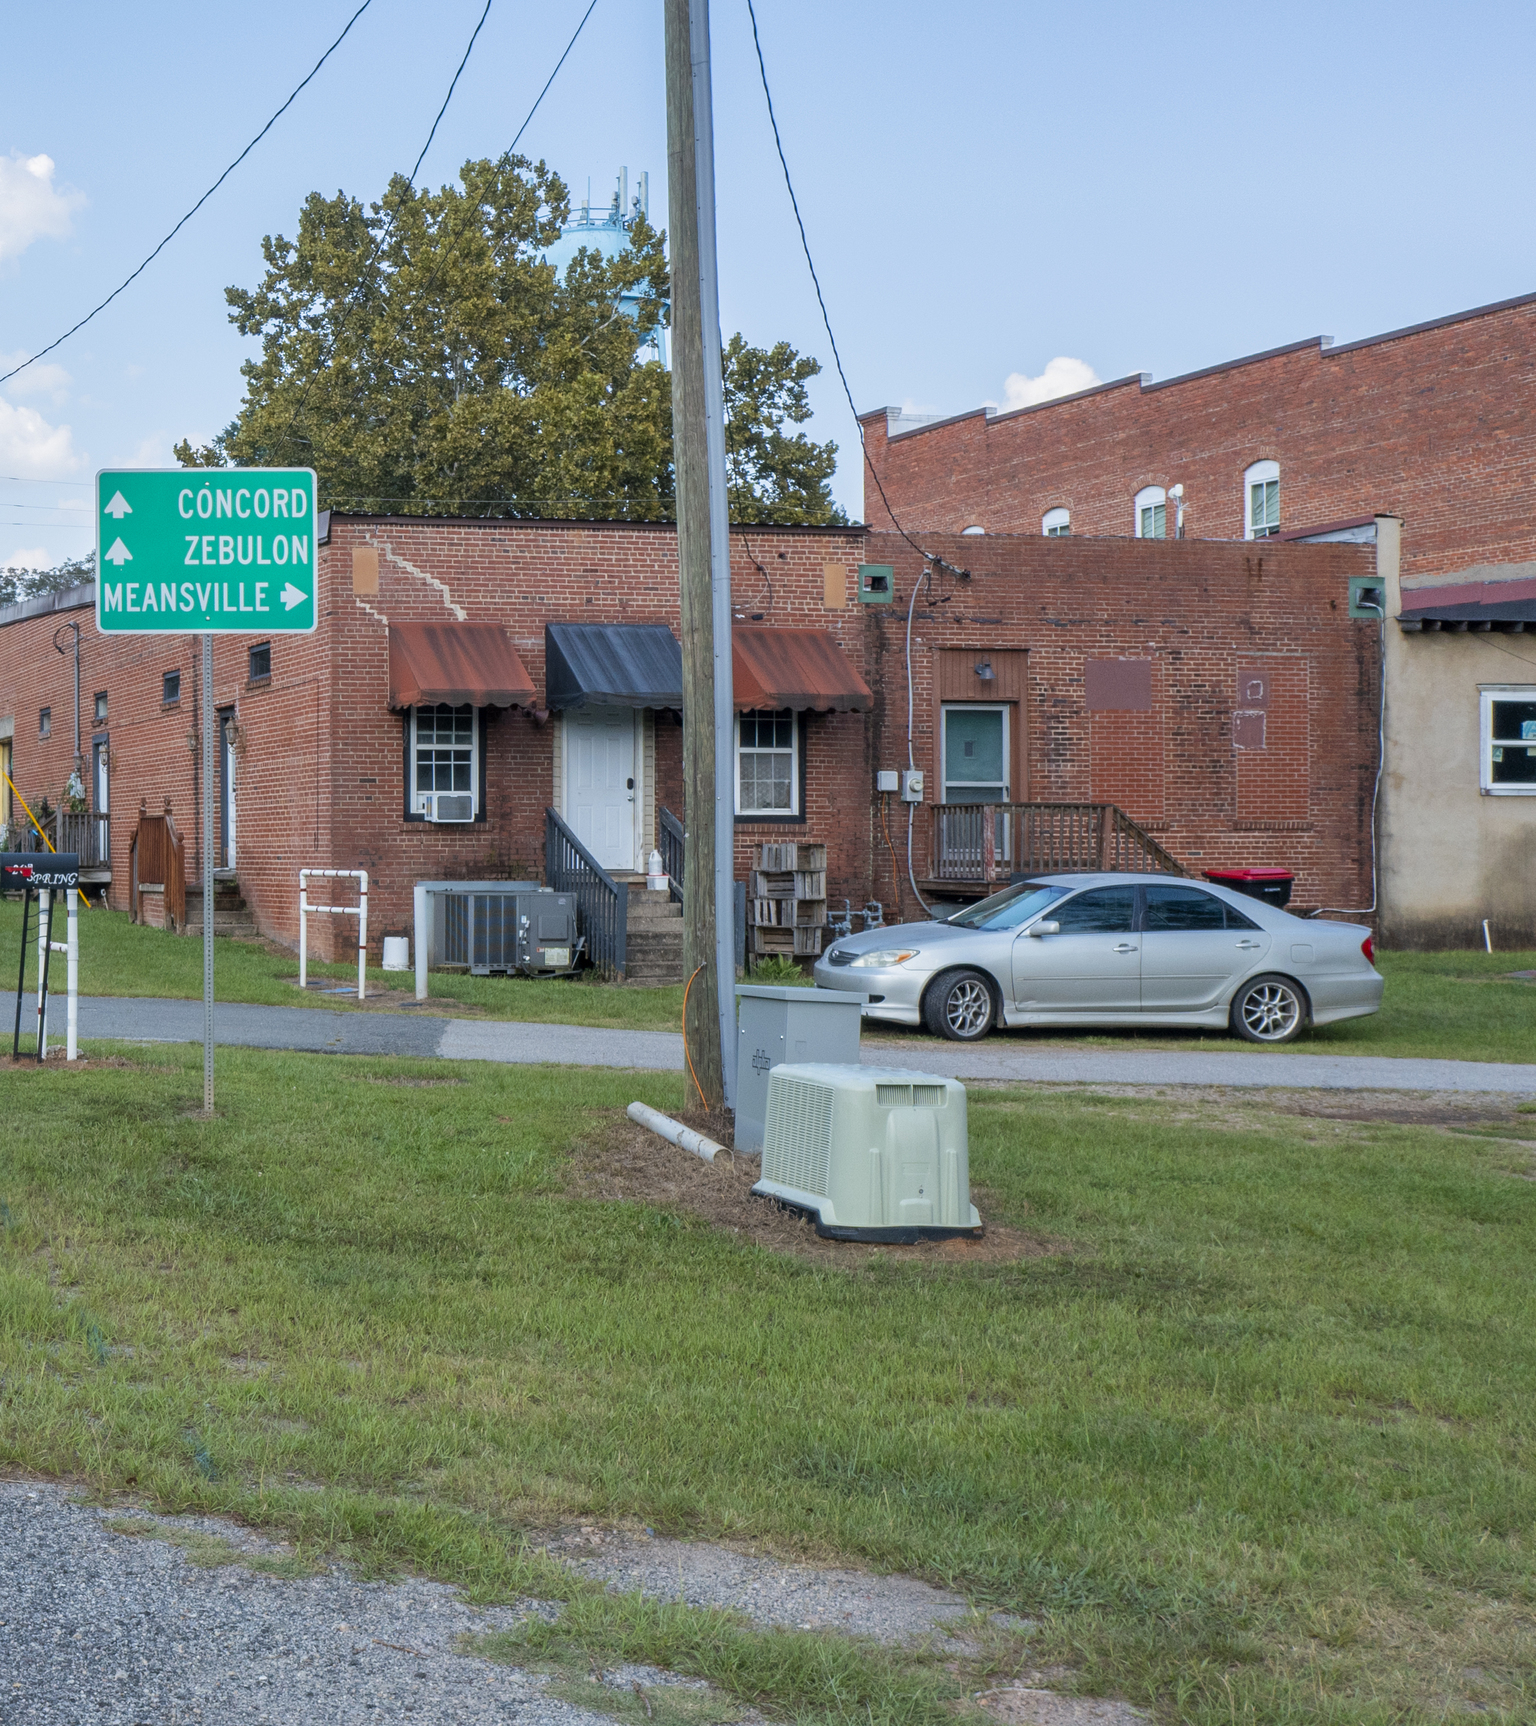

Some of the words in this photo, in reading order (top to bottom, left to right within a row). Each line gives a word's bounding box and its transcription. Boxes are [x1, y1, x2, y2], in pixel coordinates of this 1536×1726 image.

[178, 488, 308, 519] CONCORD
[184, 535, 309, 565] ZEBULON
[104, 582, 270, 612] MEANSVILLE
[26, 872, 79, 886] SPRING
